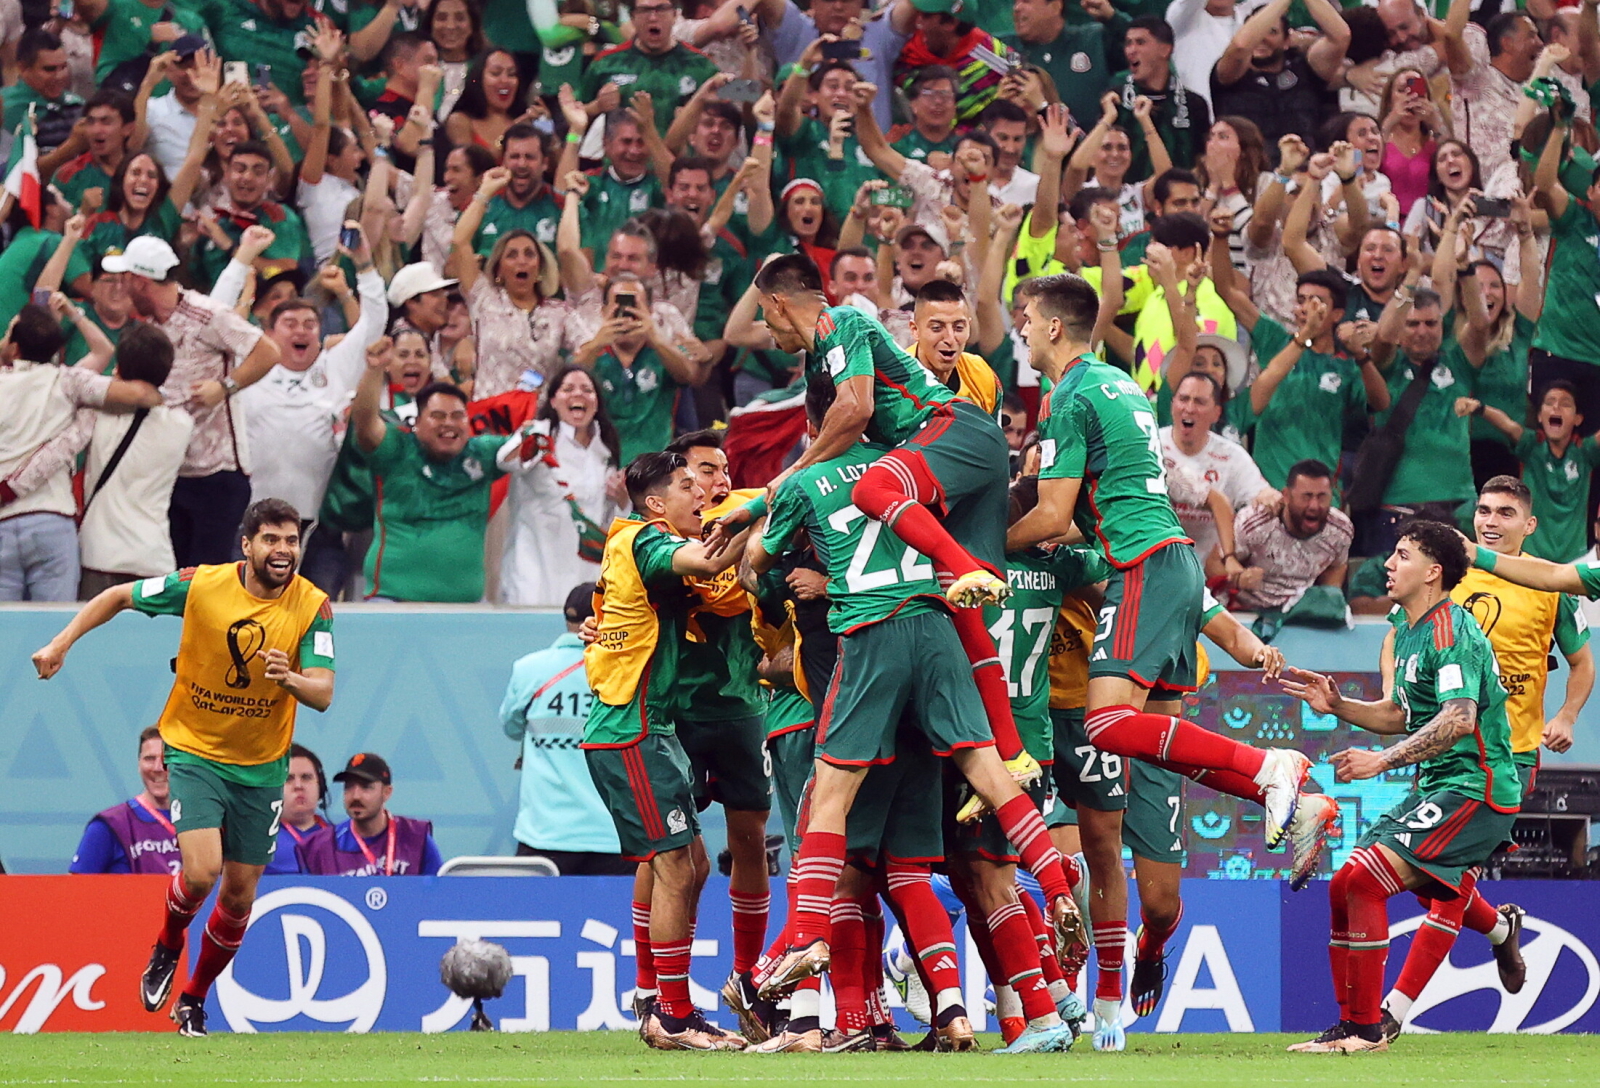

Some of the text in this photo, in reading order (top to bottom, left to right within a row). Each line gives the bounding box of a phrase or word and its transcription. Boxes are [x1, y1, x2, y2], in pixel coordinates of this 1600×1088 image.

[815, 462, 877, 497] H. LOZ
[609, 631, 629, 641] CUP
[987, 606, 1055, 698] 17
[1510, 673, 1530, 684] CUP
[191, 682, 211, 700] FIFA
[213, 692, 256, 707] WORLD
